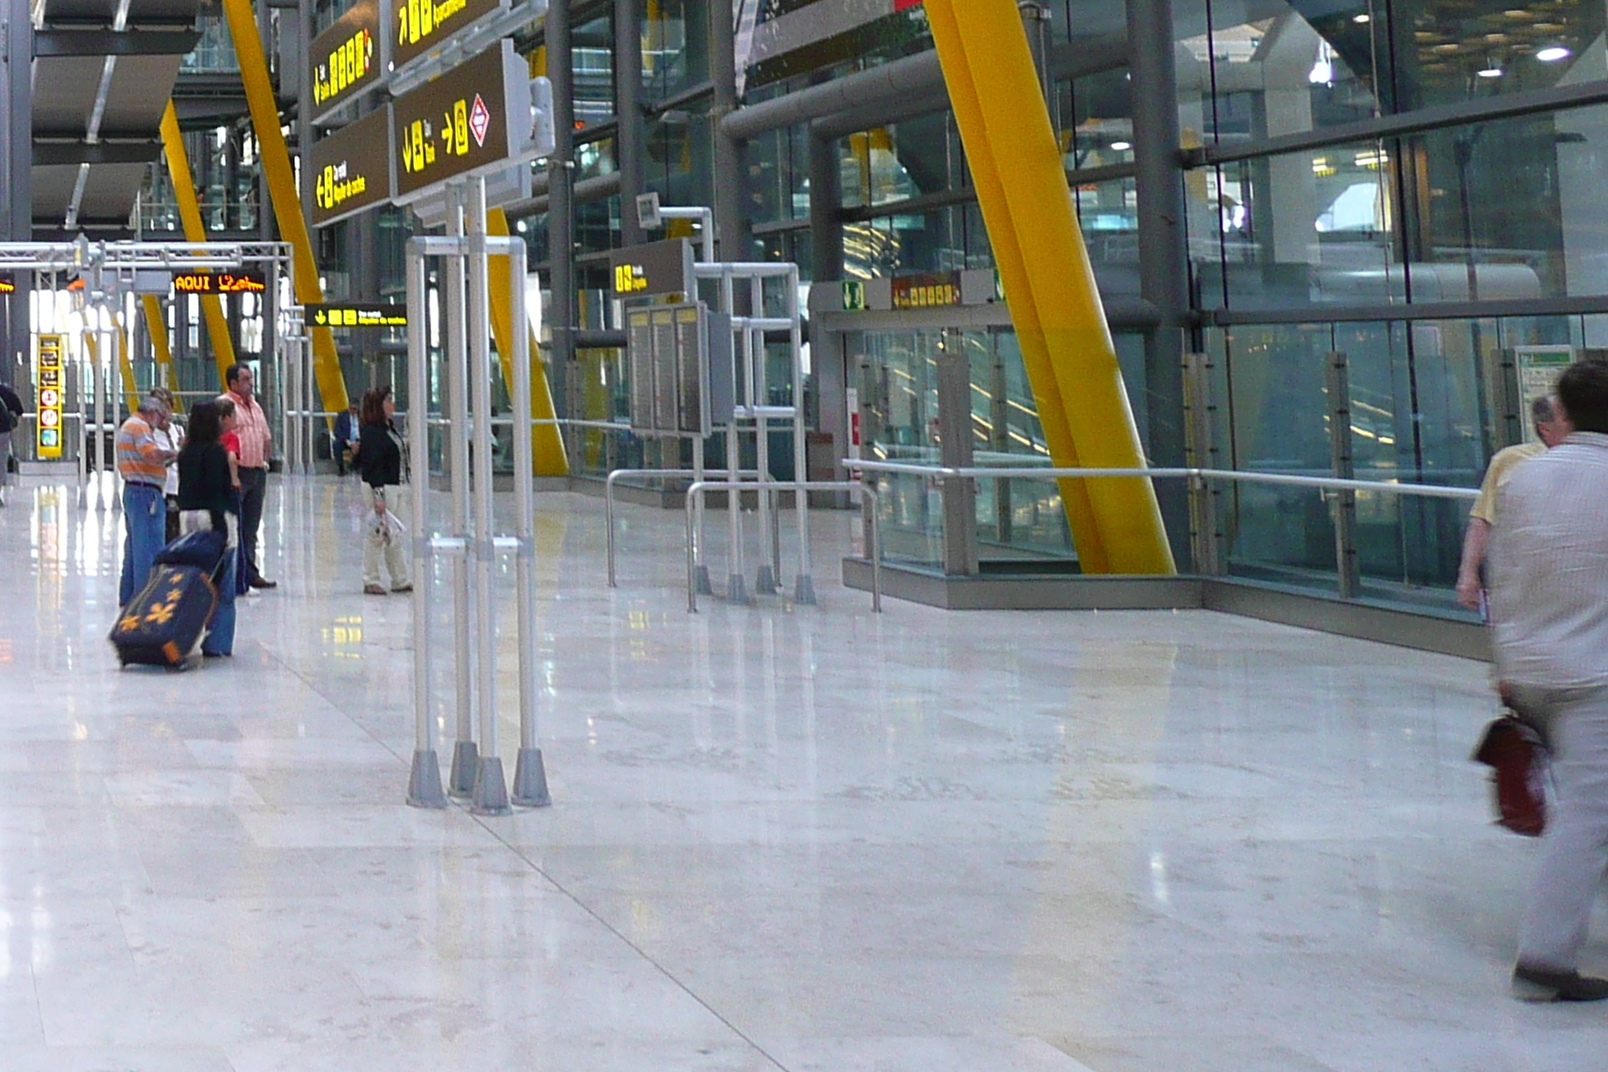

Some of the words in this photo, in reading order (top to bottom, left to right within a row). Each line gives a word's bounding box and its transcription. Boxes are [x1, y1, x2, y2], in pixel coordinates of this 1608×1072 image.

[346, 178, 352, 197] de
[352, 174, 365, 195] coches
[175, 275, 211, 291] AQUI
